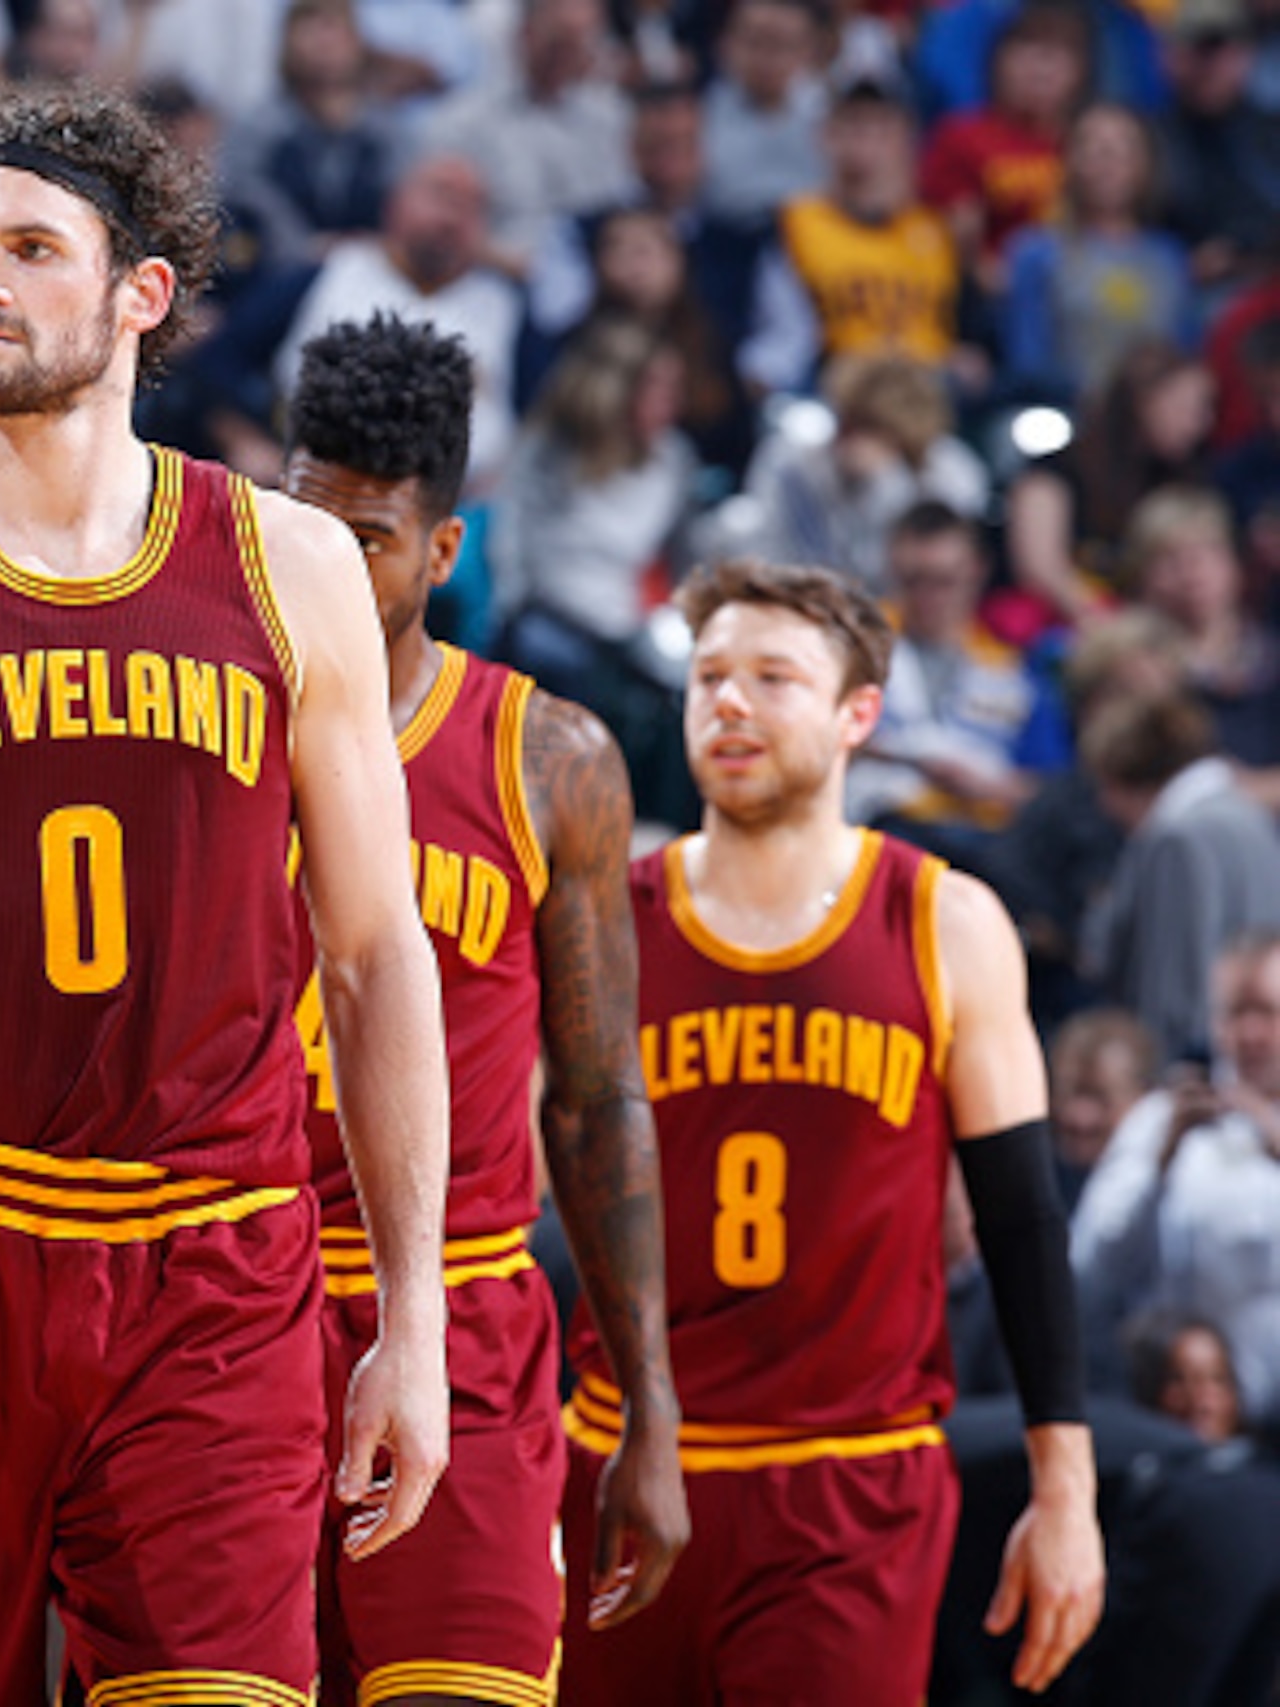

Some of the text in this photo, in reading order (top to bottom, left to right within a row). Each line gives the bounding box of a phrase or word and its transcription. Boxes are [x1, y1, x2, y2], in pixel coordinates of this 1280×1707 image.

[39, 804, 128, 994] 0
[639, 1004, 924, 1129] LEVELAND
[713, 1131, 787, 1289] 8
